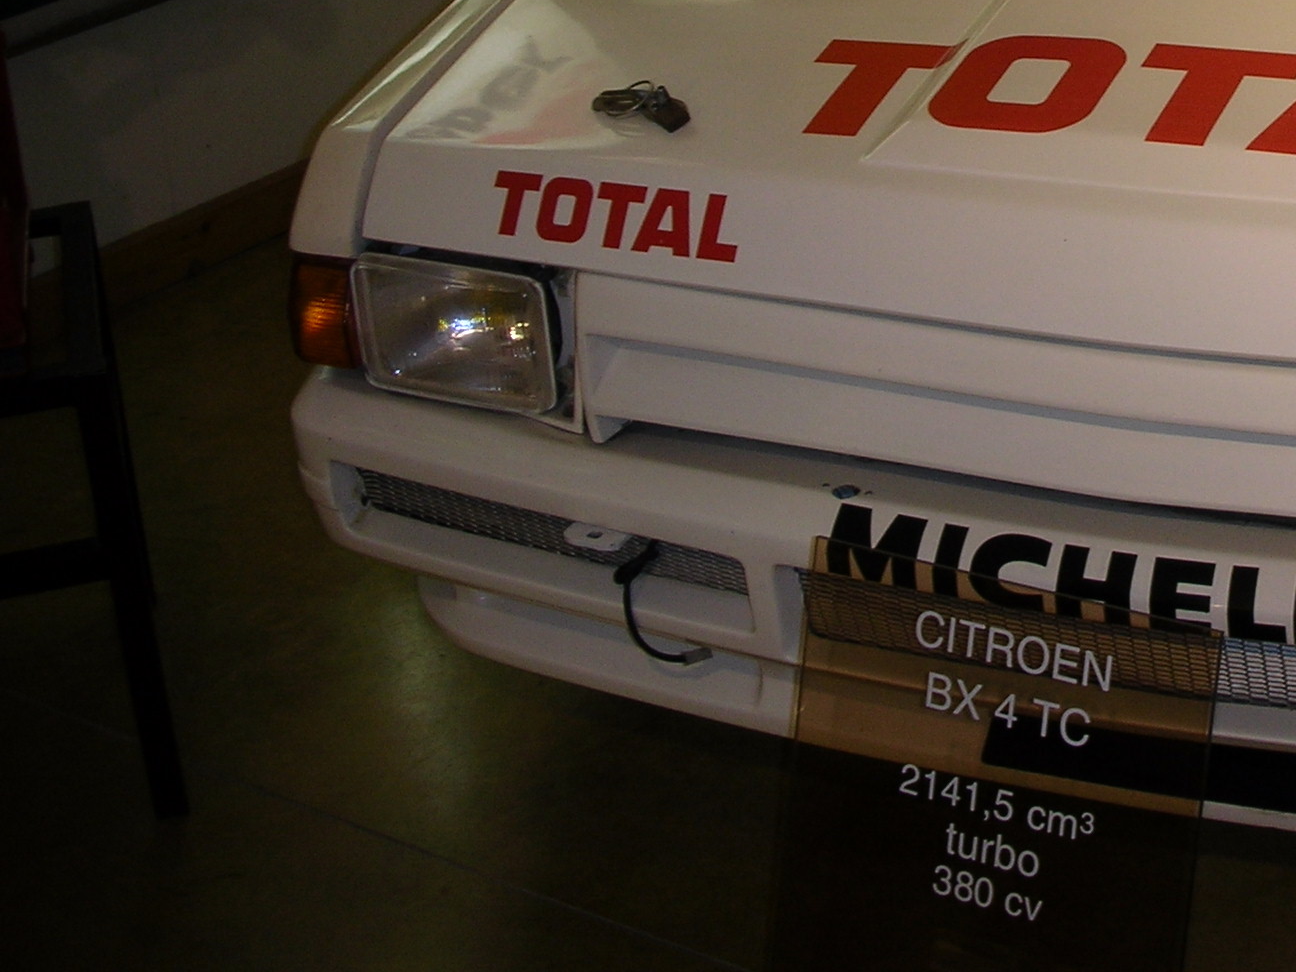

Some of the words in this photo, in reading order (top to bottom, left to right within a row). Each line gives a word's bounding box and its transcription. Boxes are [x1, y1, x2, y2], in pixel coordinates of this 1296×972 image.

[493, 169, 738, 263] TOTAL
[914, 610, 1114, 692] CITROEN
[924, 671, 983, 722] BX
[993, 690, 1019, 730] 4
[1034, 699, 1092, 747] TC
[898, 764, 1016, 822] 2141,5
[944, 823, 1040, 879] turbo
[931, 865, 995, 910] 380
[1004, 889, 1044, 923] cv
